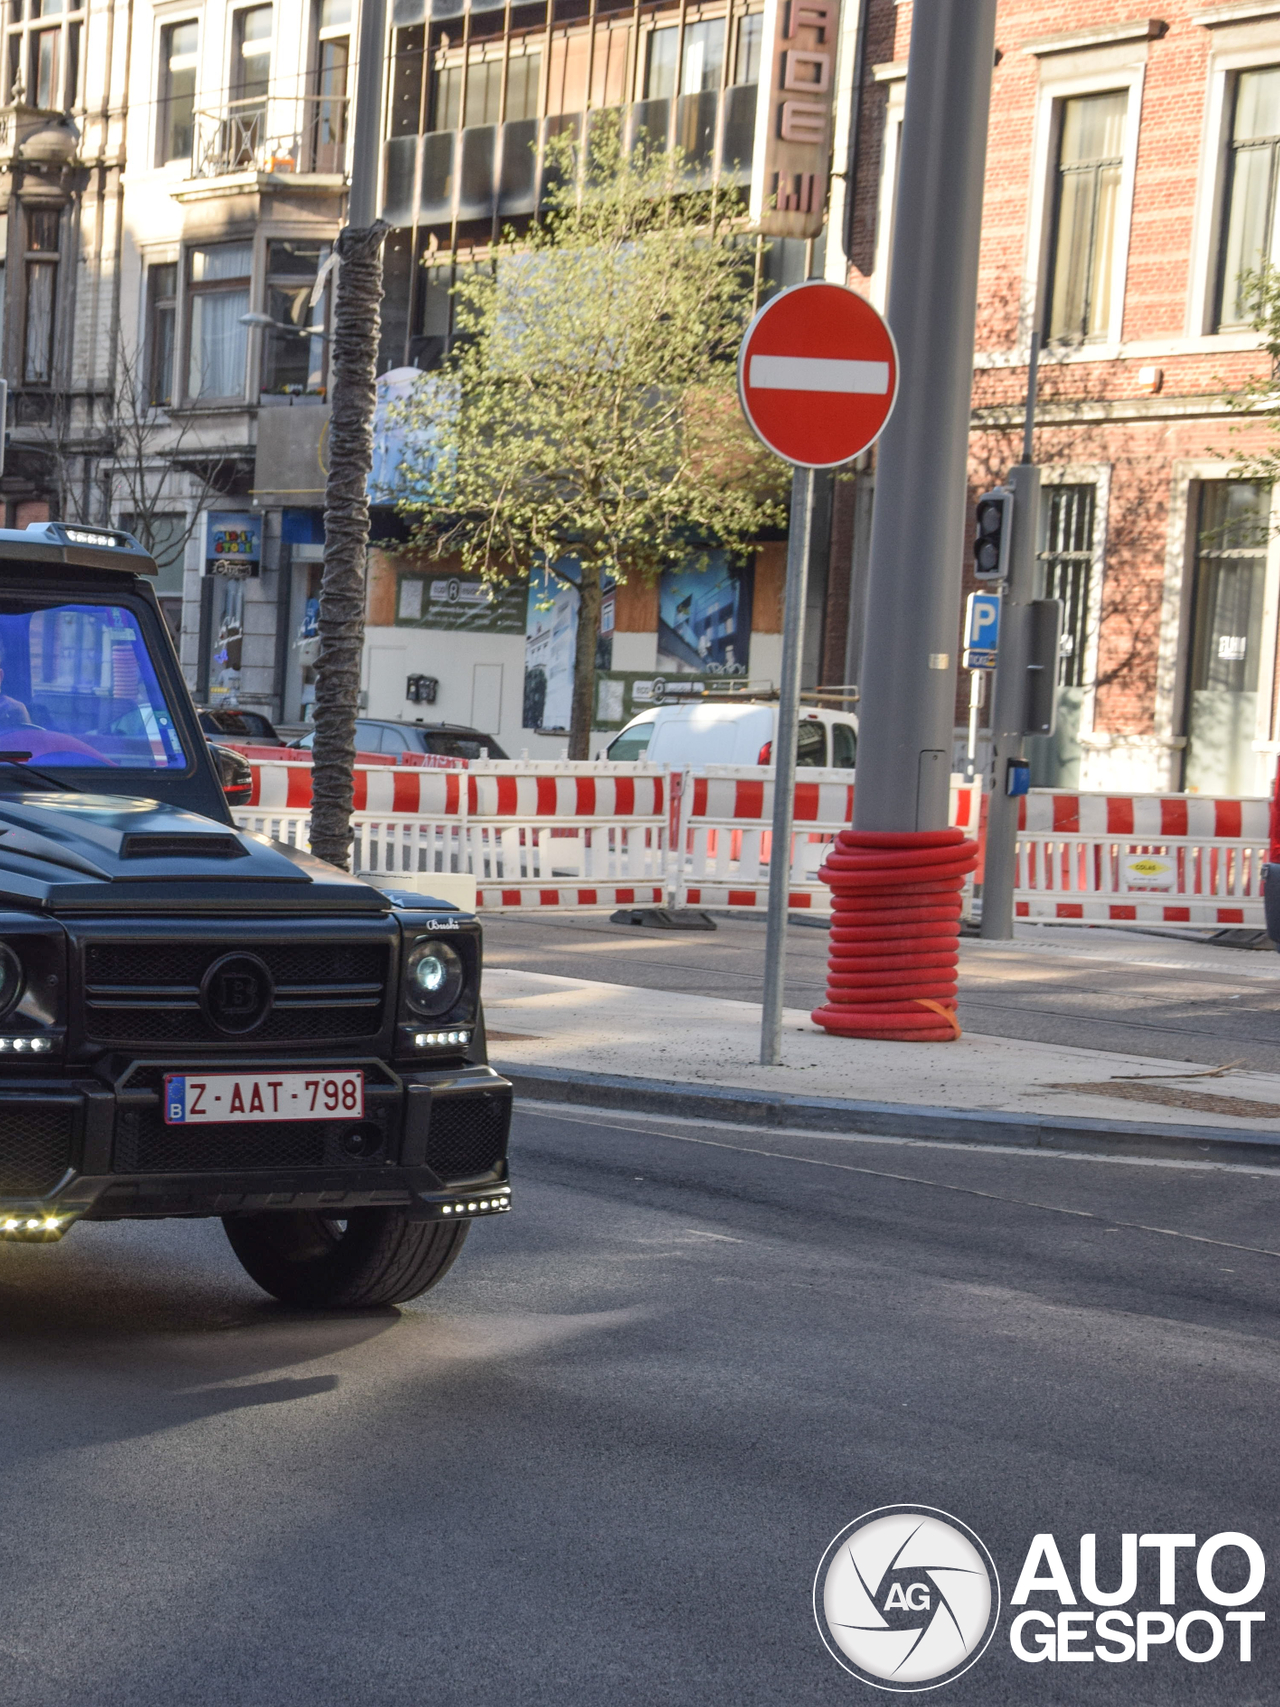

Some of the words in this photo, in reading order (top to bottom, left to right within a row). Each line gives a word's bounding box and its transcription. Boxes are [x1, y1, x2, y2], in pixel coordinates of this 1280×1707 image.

[215, 541, 254, 553] STORE
[972, 603, 996, 641] P
[170, 1103, 183, 1118] B
[189, 1079, 358, 1116] Z-AAT-798
